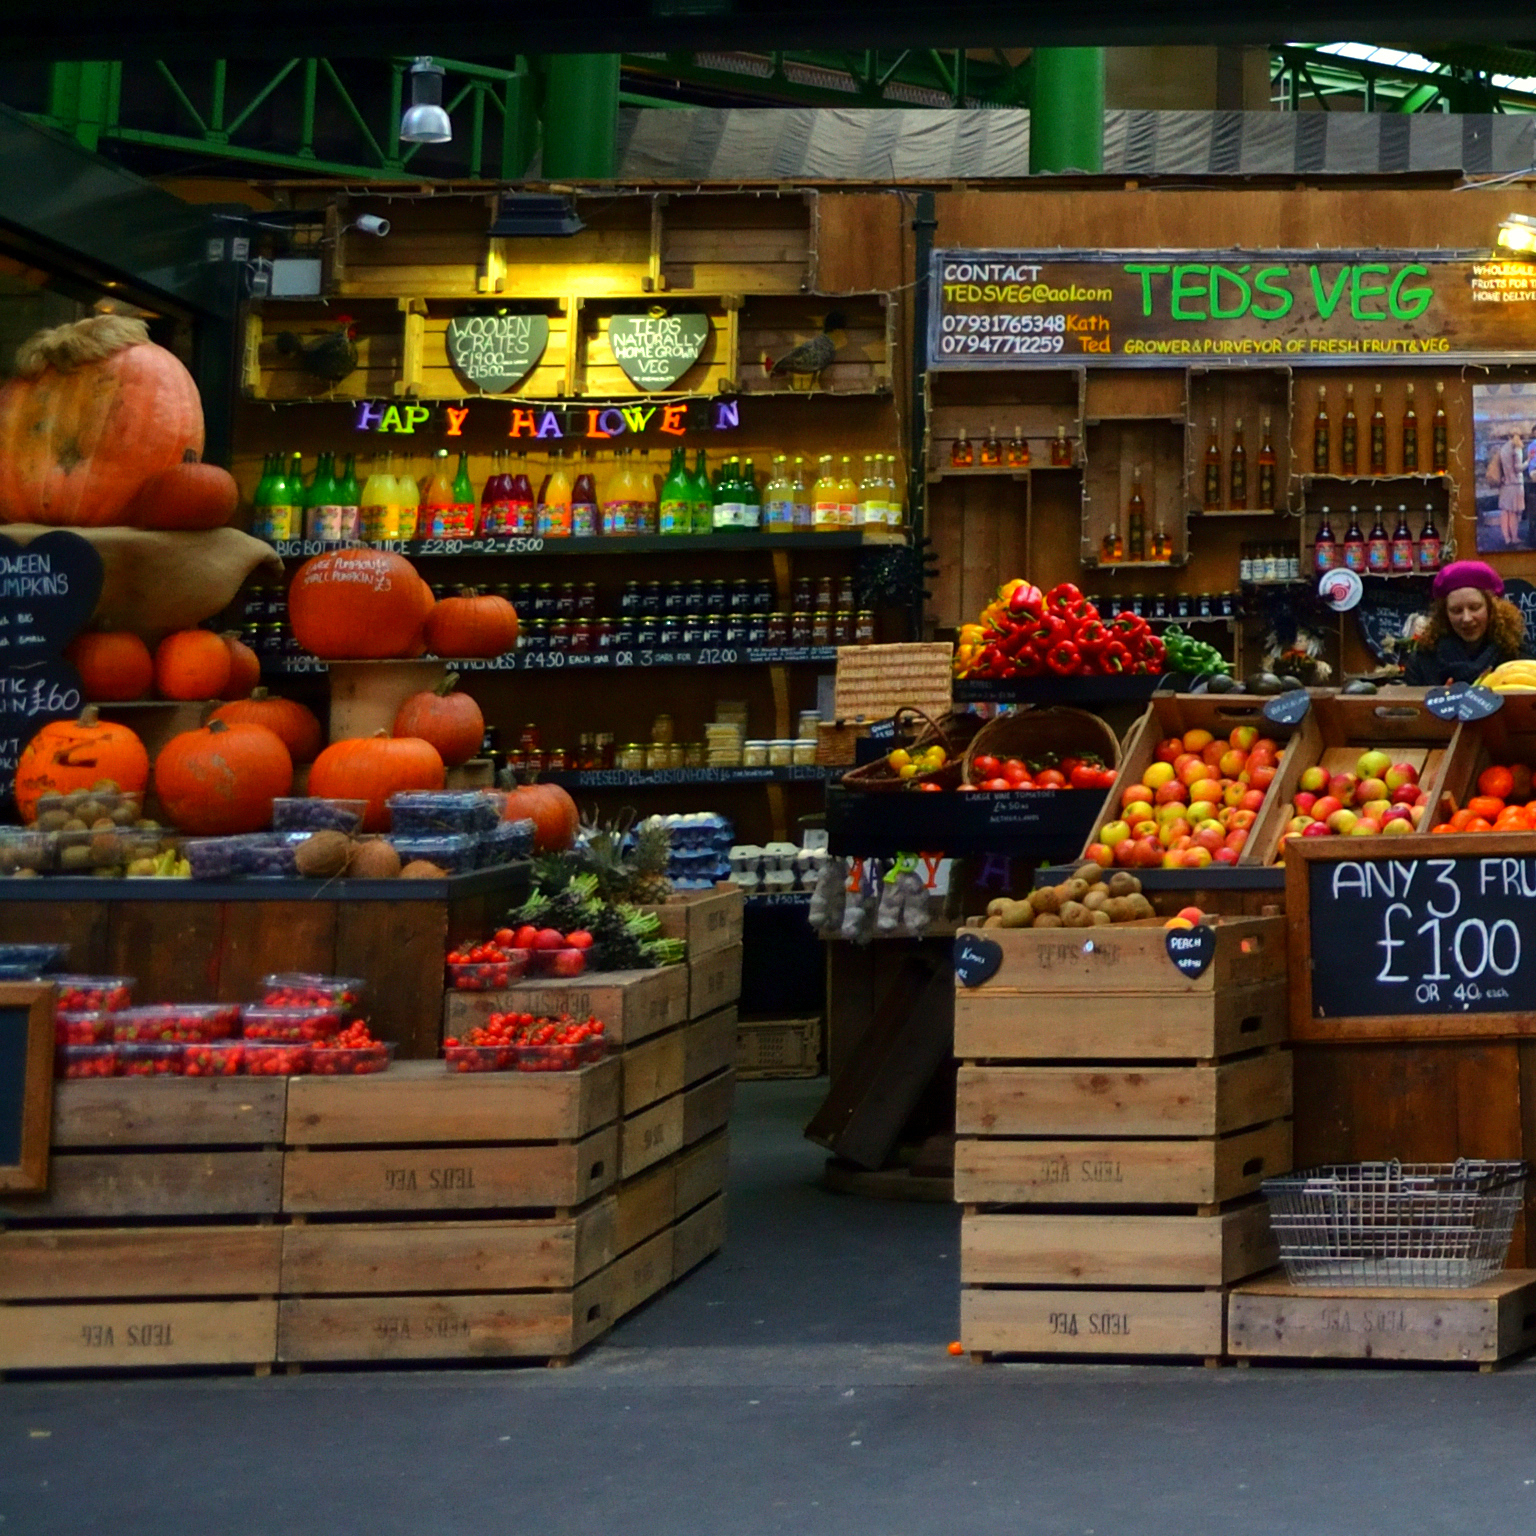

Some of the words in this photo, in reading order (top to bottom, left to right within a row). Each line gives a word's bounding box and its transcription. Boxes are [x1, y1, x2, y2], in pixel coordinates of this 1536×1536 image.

[943, 264, 1043, 282] CONTACT
[1309, 264, 1433, 321] VEG
[1508, 279, 1528, 289] FOR
[1472, 290, 1501, 301] HOME
[450, 316, 532, 338] WOODEN
[942, 314, 1066, 333] 07931765348
[1066, 314, 1110, 332] Kath
[456, 333, 530, 354] CRATES
[612, 332, 708, 349] NATURALLY
[942, 335, 1065, 354] 07947712259
[1078, 335, 1111, 353] Ted
[1286, 339, 1307, 353] OF
[1310, 338, 1360, 353] FRESH
[1419, 337, 1450, 353] VEG
[637, 360, 670, 374] VEG
[276, 540, 301, 557] BIG
[372, 539, 410, 555] JUICE
[615, 651, 635, 666] OR
[639, 650, 654, 666] 3
[1332, 860, 1419, 899] ANY
[1426, 859, 1461, 919] 3
[1170, 937, 1202, 950] PEACH
[1415, 983, 1441, 1004] OR
[385, 1169, 417, 1191] VEG
[1049, 1312, 1078, 1335] VEG
[81, 1324, 115, 1347] VEG
